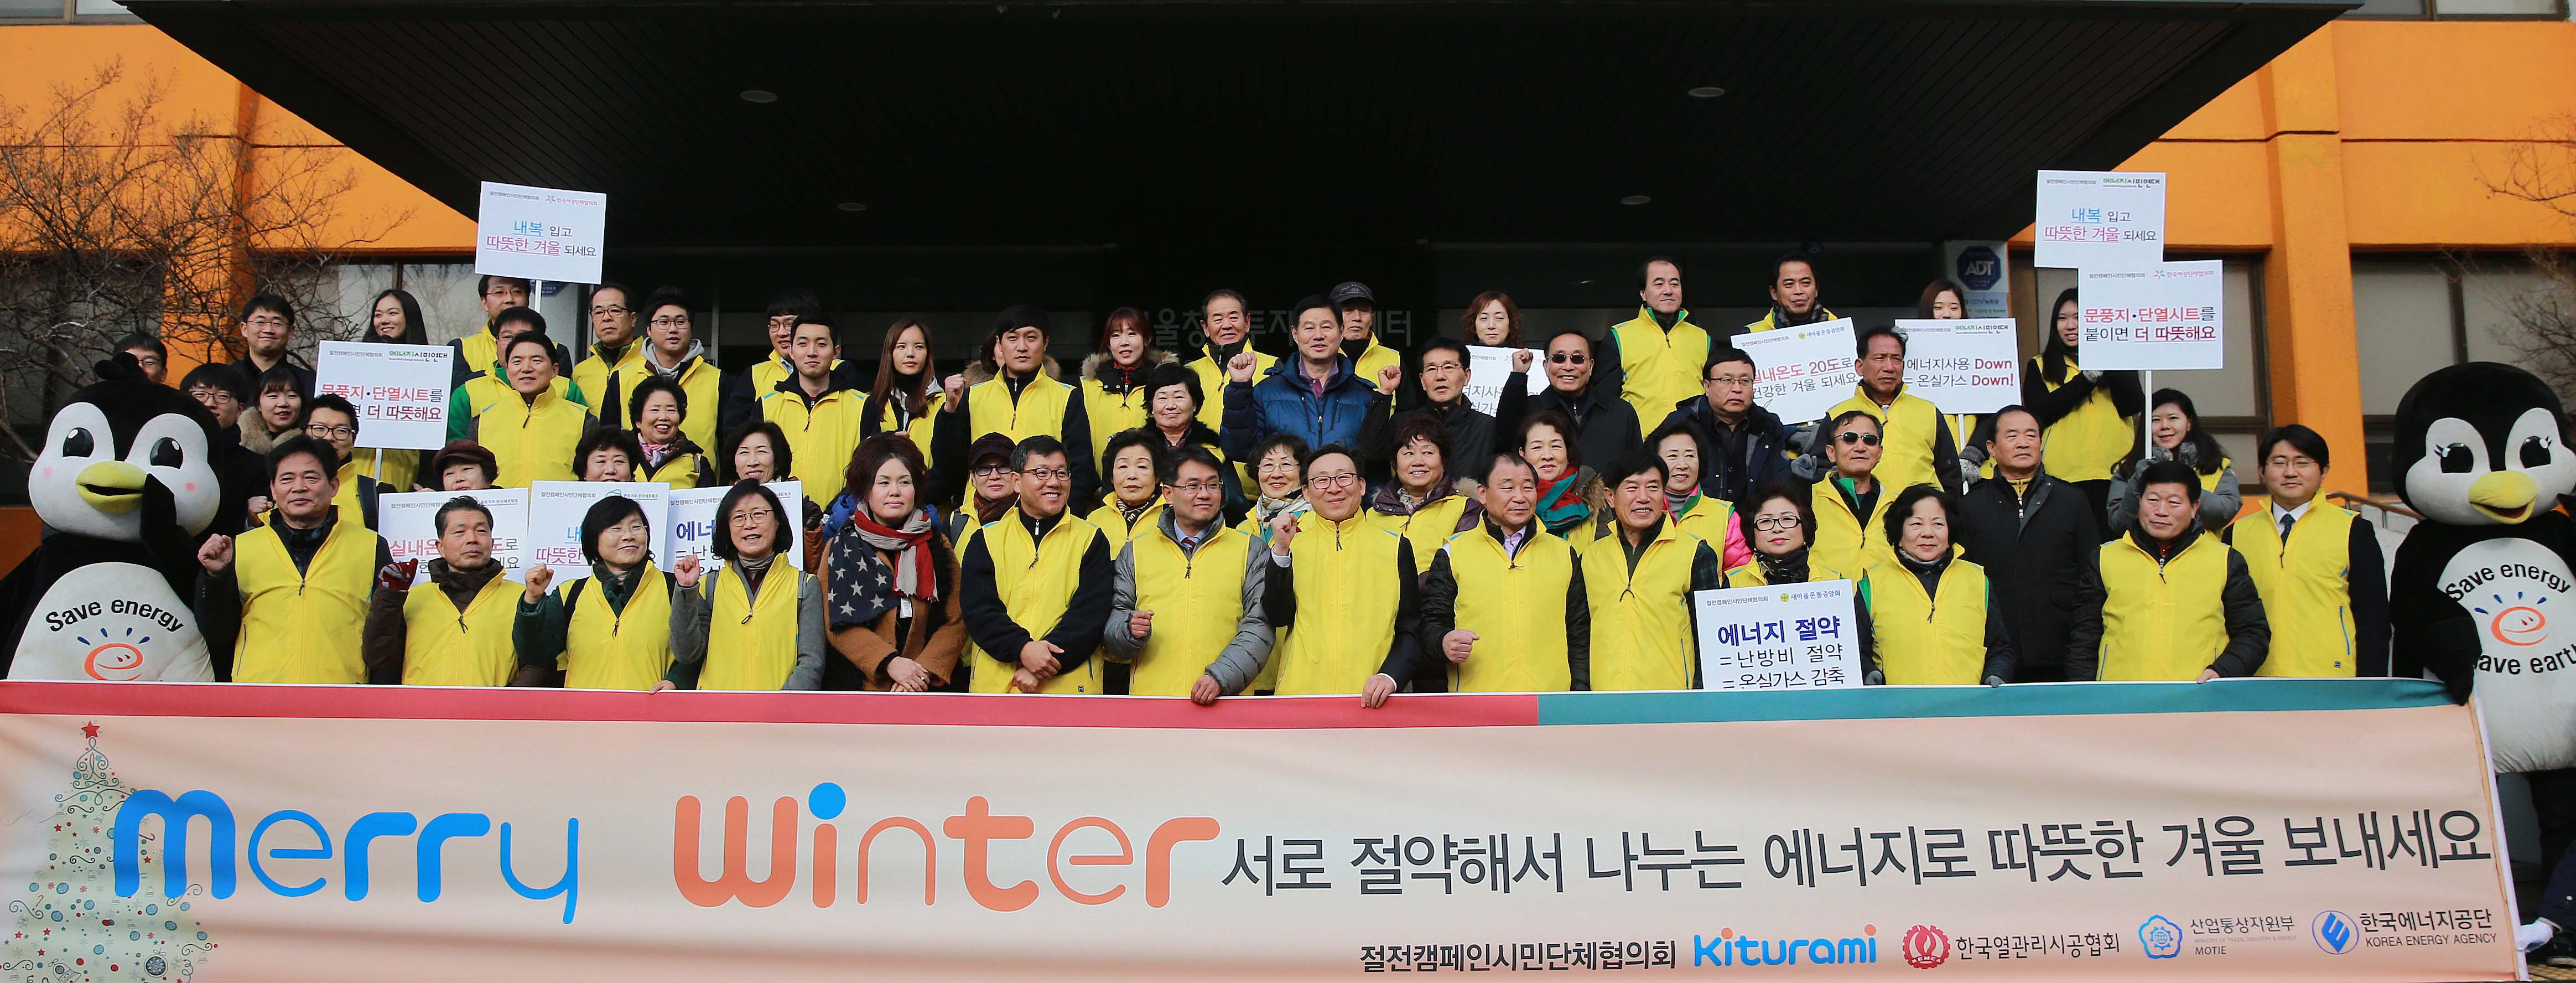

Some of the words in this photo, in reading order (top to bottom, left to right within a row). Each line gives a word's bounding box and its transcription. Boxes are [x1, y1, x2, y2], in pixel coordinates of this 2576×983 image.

[2072, 208, 2101, 223] 내복
[2107, 211, 2131, 223] 입고
[514, 220, 543, 236] 내복
[549, 226, 572, 237] 입고
[2045, 226, 2087, 241] 따뜻한
[2092, 226, 2120, 242] 겨울
[2123, 230, 2157, 242] 되세요
[486, 236, 529, 252] 따뜻한
[534, 240, 562, 255] 겨울
[564, 245, 597, 257] 되세요
[1965, 261, 1995, 276] ADT
[2084, 307, 2216, 323] 문풍지·단열시트를
[2084, 327, 2129, 342] 붙이면
[2135, 327, 2149, 341] 더
[2156, 325, 2216, 340] 따뜻해요
[389, 350, 448, 363] 에너지시민연대
[1907, 358, 1970, 371] 에너지사용
[1975, 358, 2013, 370] Down
[1809, 358, 1853, 375] 20도로
[1791, 379, 1816, 393] 겨울
[1821, 372, 1858, 388] 되세요
[1918, 374, 1967, 387] 온실가스
[1971, 374, 2014, 386] Down!
[368, 405, 381, 419] 더
[387, 406, 442, 421] 따뜻해요
[536, 546, 584, 565] 따뜻한
[2445, 567, 2495, 602] Save
[2500, 563, 2572, 593] energy
[1790, 589, 1841, 601] 새마을운동중앙회
[45, 601, 102, 632] Save
[111, 599, 184, 632] energy
[1718, 619, 1786, 647] 에너지
[1795, 615, 1841, 641] 절약
[1737, 646, 1795, 669] 난방비
[1806, 643, 1844, 663] 절약
[2479, 655, 2521, 675] ave
[1810, 666, 1846, 687] 감축
[1221, 834, 1331, 896] 서로
[1350, 831, 1564, 895] 절약해서
[1587, 829, 1745, 892] 나누는
[1763, 825, 1977, 888] 에너지로
[1990, 818, 2144, 883] 따뜻한
[2165, 815, 2265, 877] 겨울
[2283, 809, 2492, 872] 보내세요
[2190, 915, 2295, 934] 산업통상자원부
[2359, 908, 2492, 933] 한국에너지공단
[1694, 924, 1877, 966] Kiturami
[1955, 932, 2120, 960] 한국열관리시공협회
[2366, 937, 2402, 948] KOREA
[2406, 935, 2449, 946] ENERGY
[2453, 933, 2497, 944] AGENCY
[1359, 940, 1676, 974] 절전캠페인시민단체협의회
[2195, 946, 2227, 955] MOTIE
